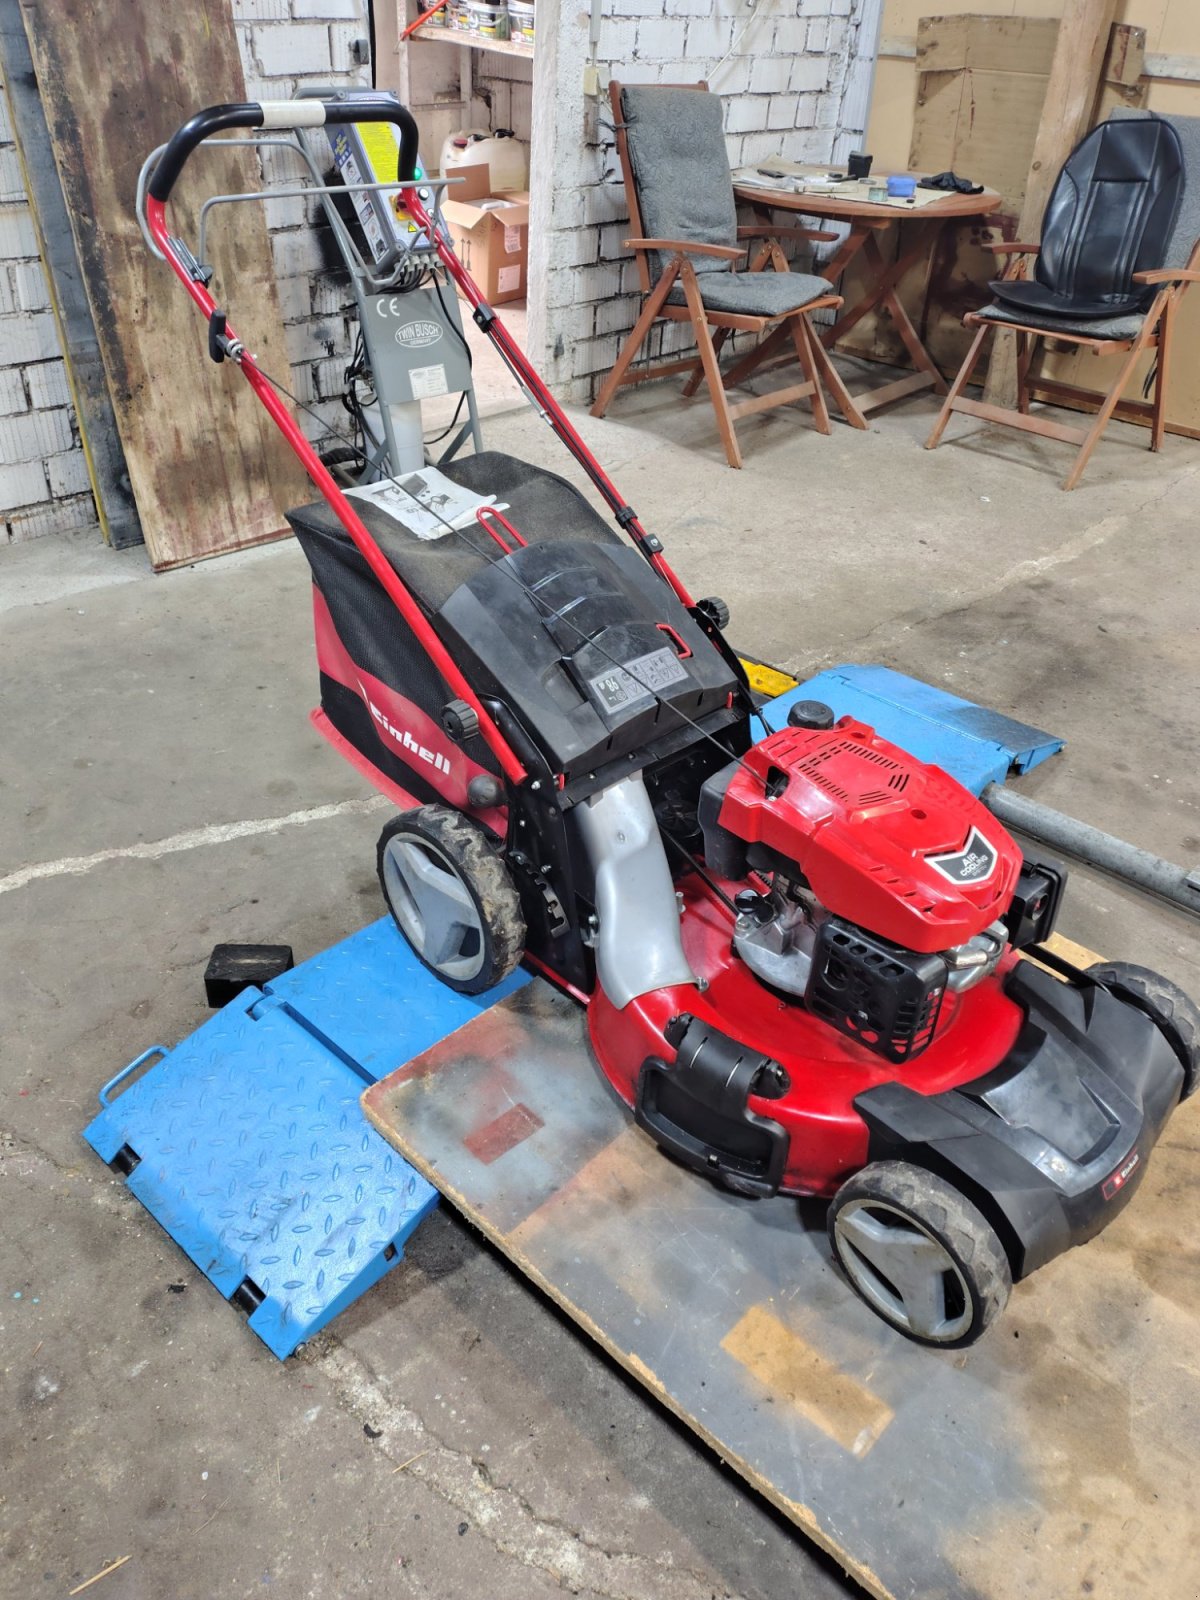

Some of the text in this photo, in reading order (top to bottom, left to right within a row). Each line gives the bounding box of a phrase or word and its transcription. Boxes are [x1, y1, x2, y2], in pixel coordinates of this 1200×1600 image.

[398, 323, 438, 340] TWIN BUSCH
[960, 854, 989, 877] COOLING
[962, 853, 978, 867] AIR
